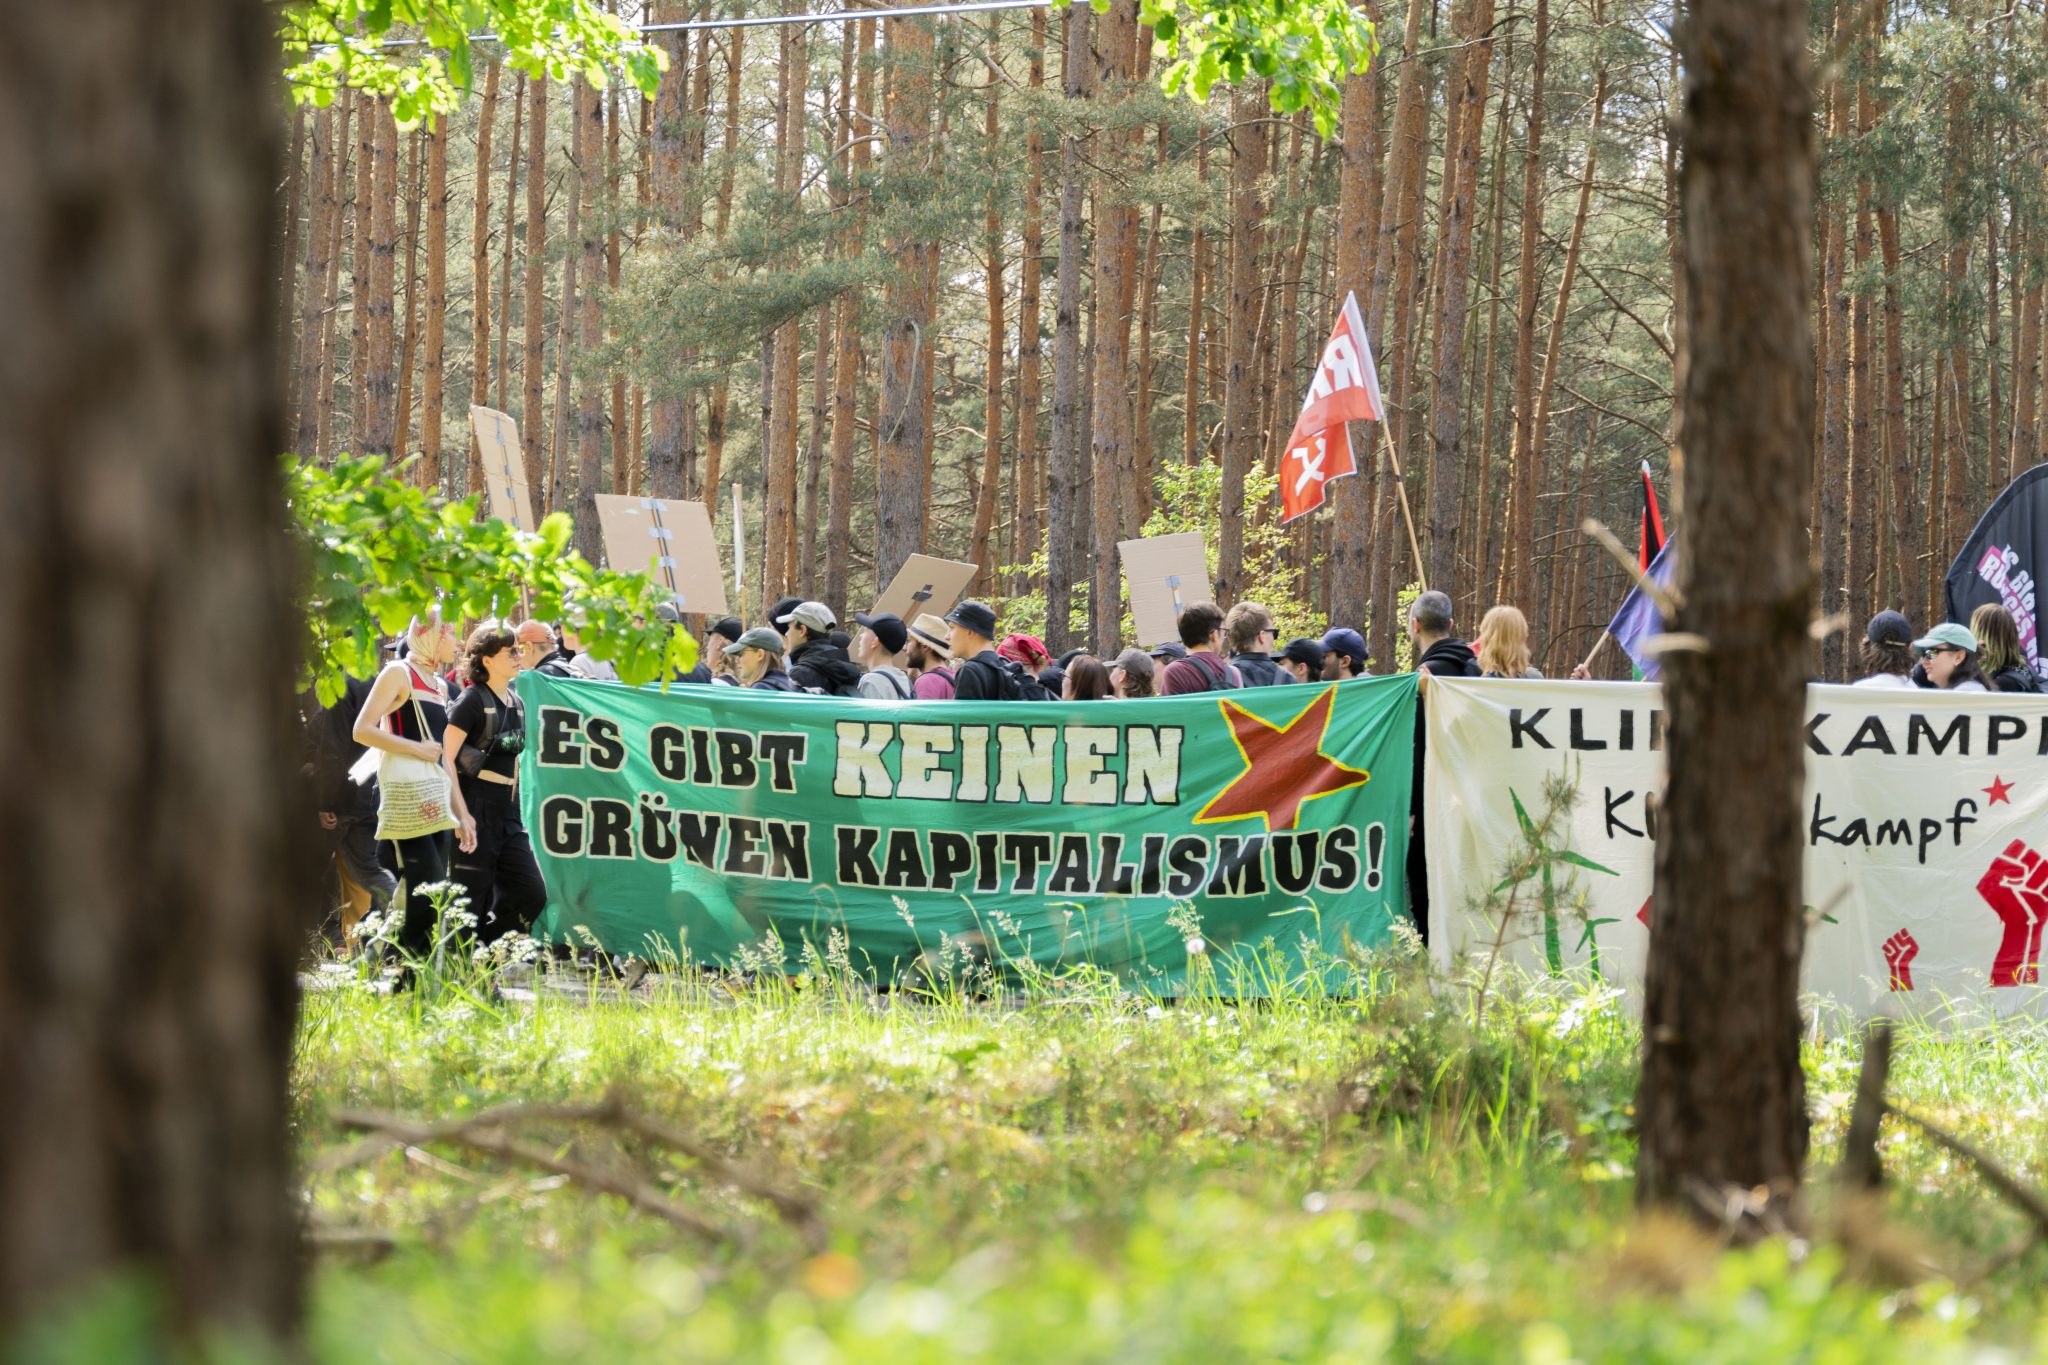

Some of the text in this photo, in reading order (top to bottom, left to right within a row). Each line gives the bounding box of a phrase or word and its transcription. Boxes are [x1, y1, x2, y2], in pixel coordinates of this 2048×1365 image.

[537, 704, 1184, 805] ES GIBT KEINEN
[540, 791, 813, 883] GRÜNEN
[834, 821, 1386, 898] KAPITALISMUS!
